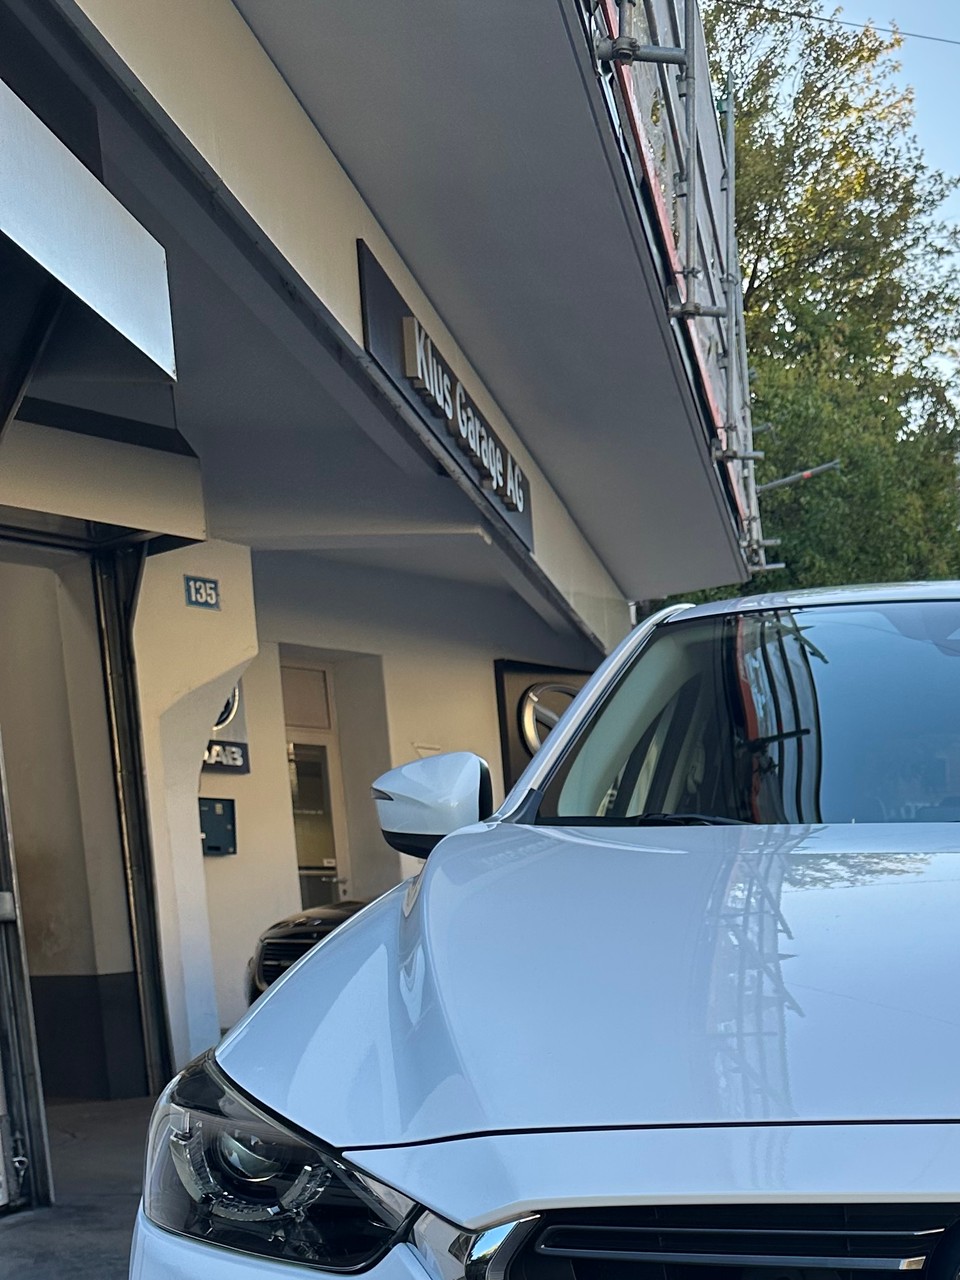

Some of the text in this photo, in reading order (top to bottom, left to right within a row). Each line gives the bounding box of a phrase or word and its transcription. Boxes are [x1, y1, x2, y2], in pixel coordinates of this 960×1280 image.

[413, 318, 524, 513] Klus Garage AG
[188, 580, 217, 605] 135
[203, 745, 244, 767] AB
